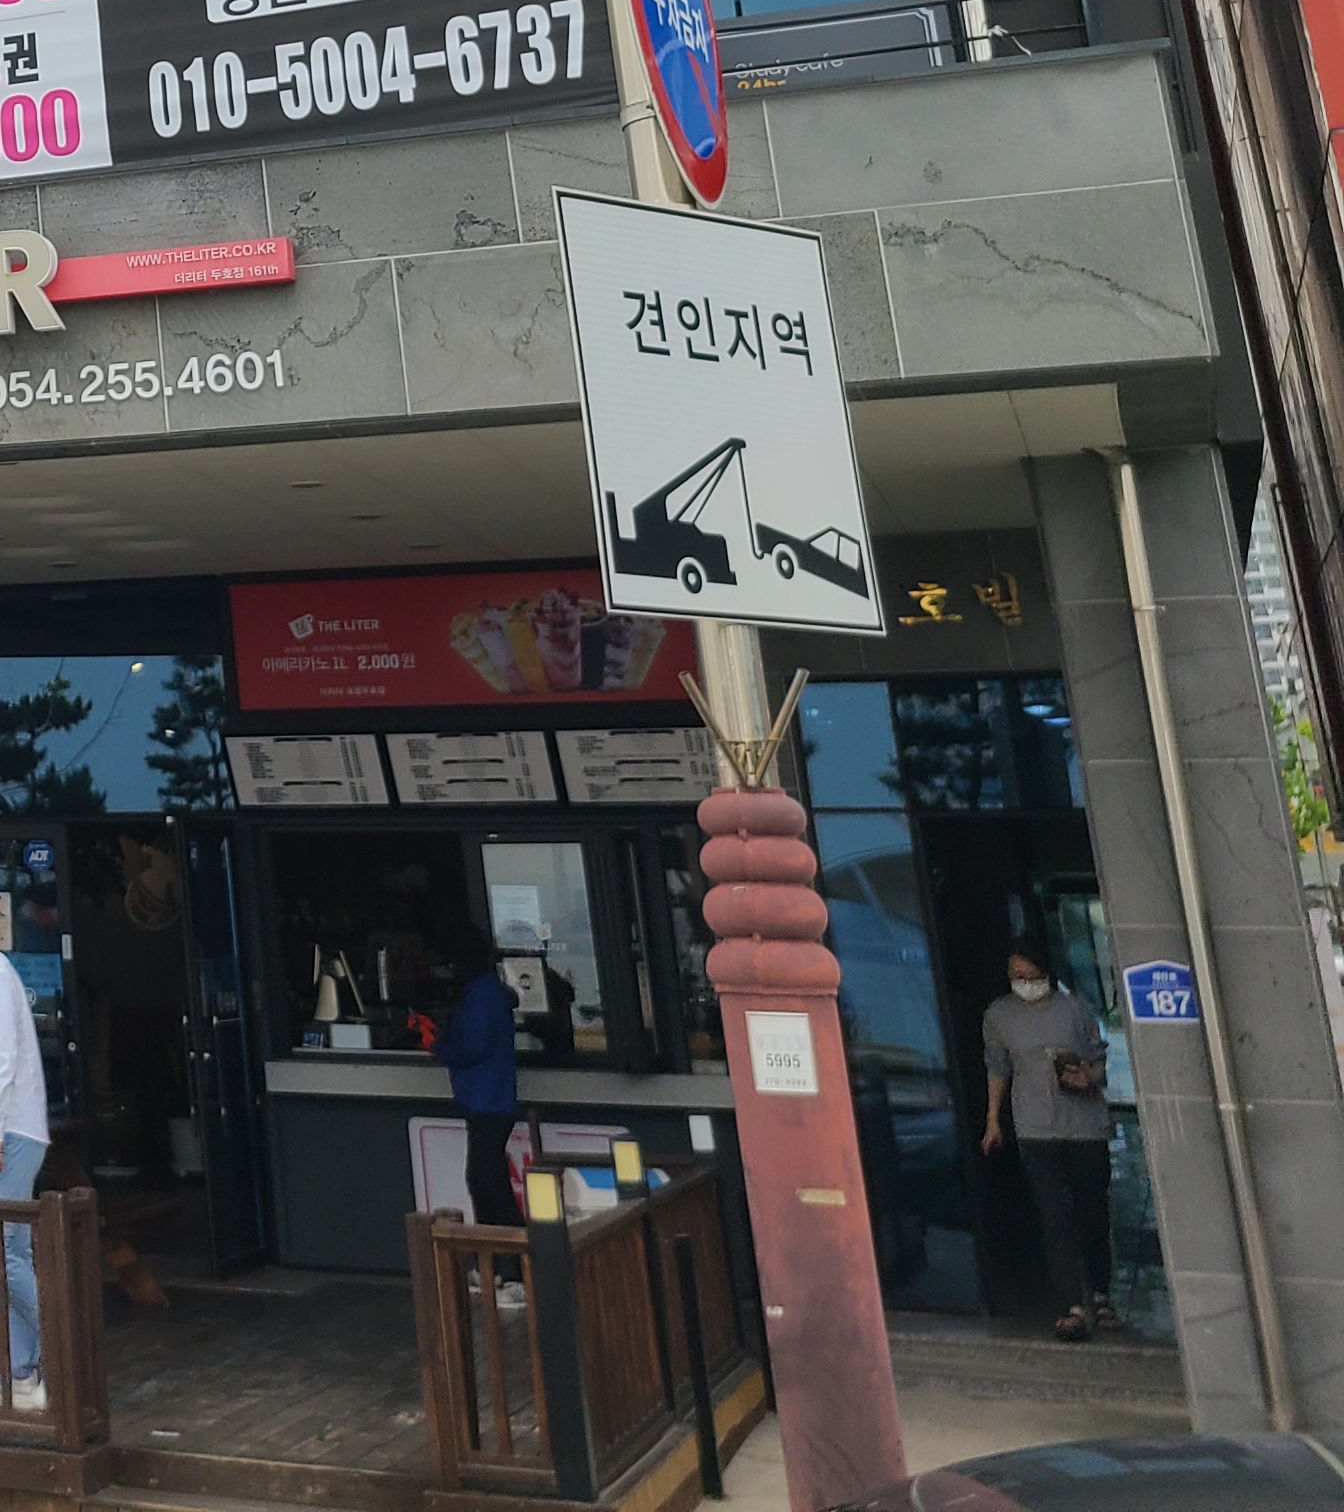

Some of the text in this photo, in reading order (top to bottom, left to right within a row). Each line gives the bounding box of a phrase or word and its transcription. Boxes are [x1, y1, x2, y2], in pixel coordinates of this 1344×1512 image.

[126, 242, 277, 268] WWW.THELITER.CO.KR
[174, 265, 279, 284] 더리터 두호점 161th
[622, 288, 815, 378] 견인지역
[318, 619, 379, 632] THE LITER
[263, 656, 330, 673] 아메리카노
[1146, 990, 1190, 1016] 187
